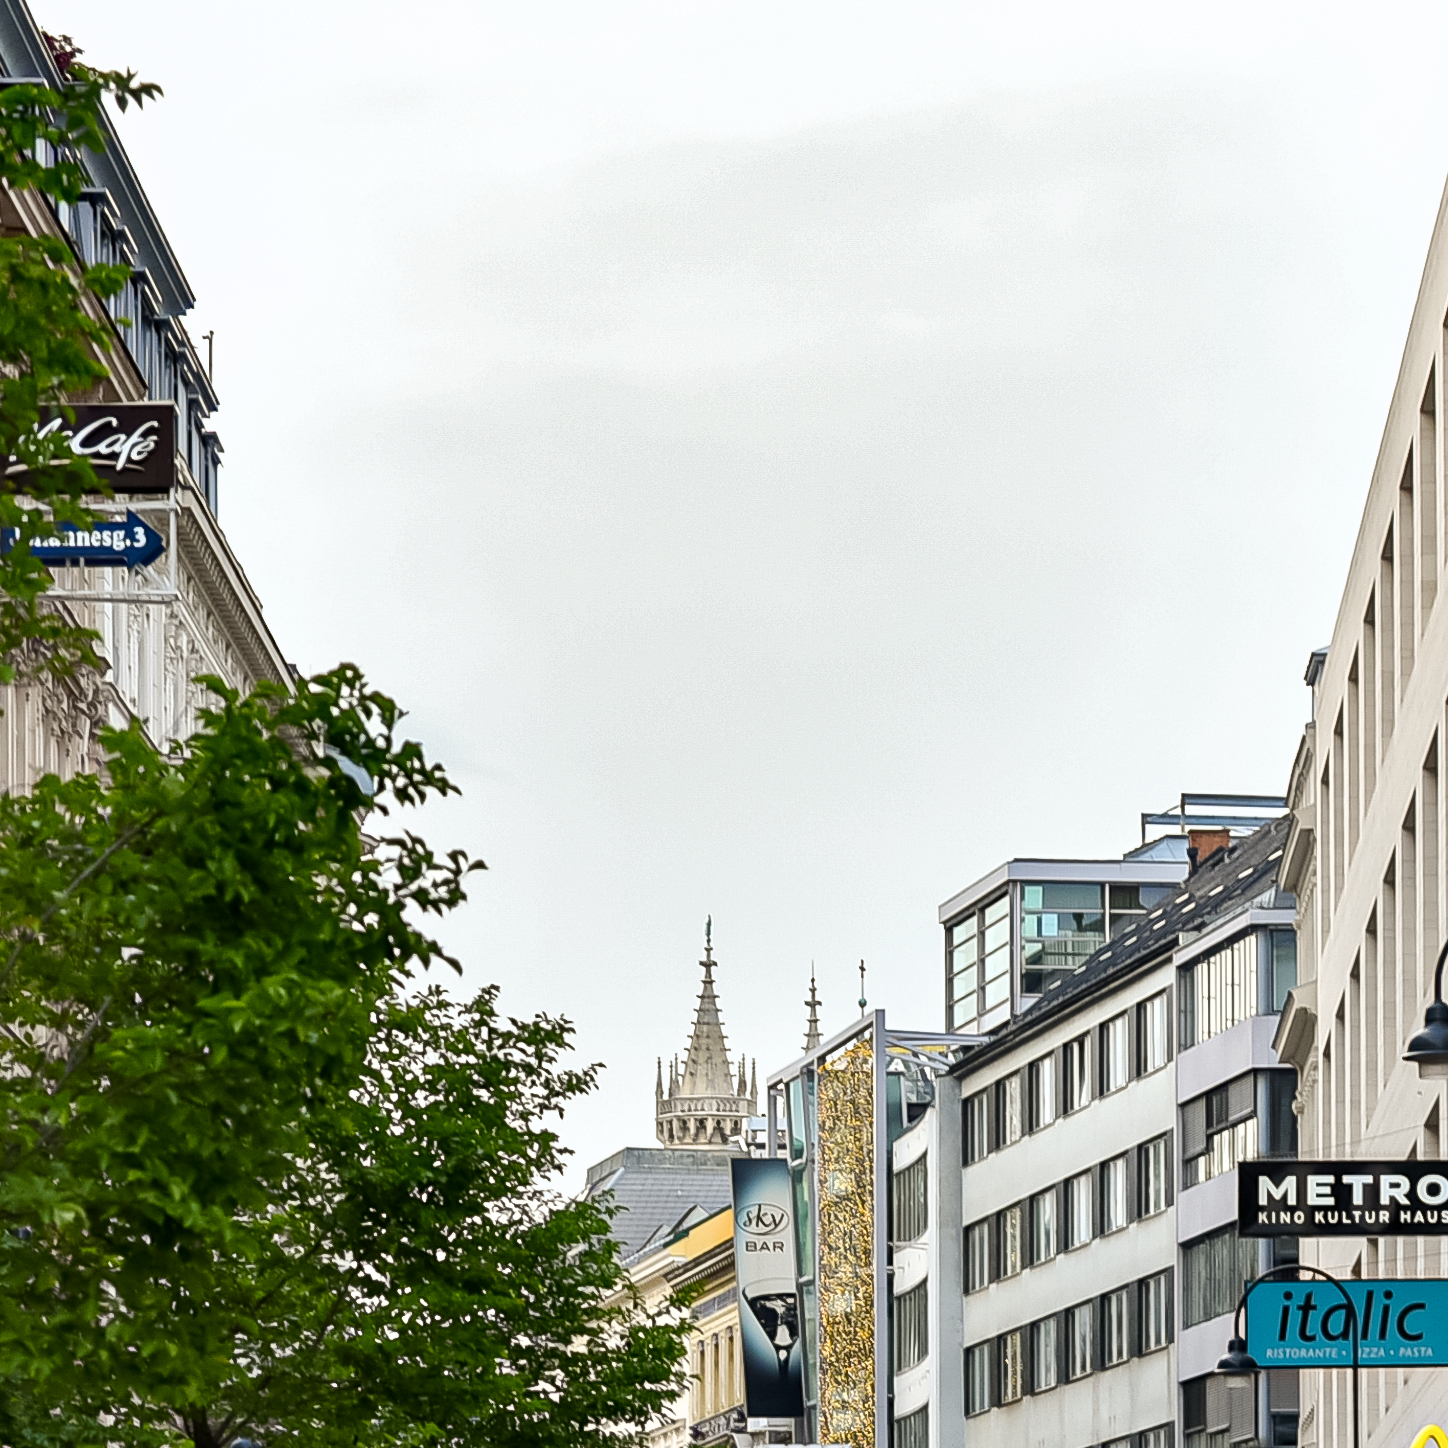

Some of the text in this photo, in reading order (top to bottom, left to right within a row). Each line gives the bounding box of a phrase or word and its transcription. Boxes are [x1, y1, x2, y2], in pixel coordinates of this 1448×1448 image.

[742, 1204, 785, 1231] sky
[1258, 1210, 1304, 1225] KINO
[1314, 1210, 1391, 1225] KULTUR
[745, 1241, 785, 1253] BAR
[1277, 1289, 1428, 1343] italic
[1266, 1347, 1434, 1360] RISTORANTE IZZA PASTA
